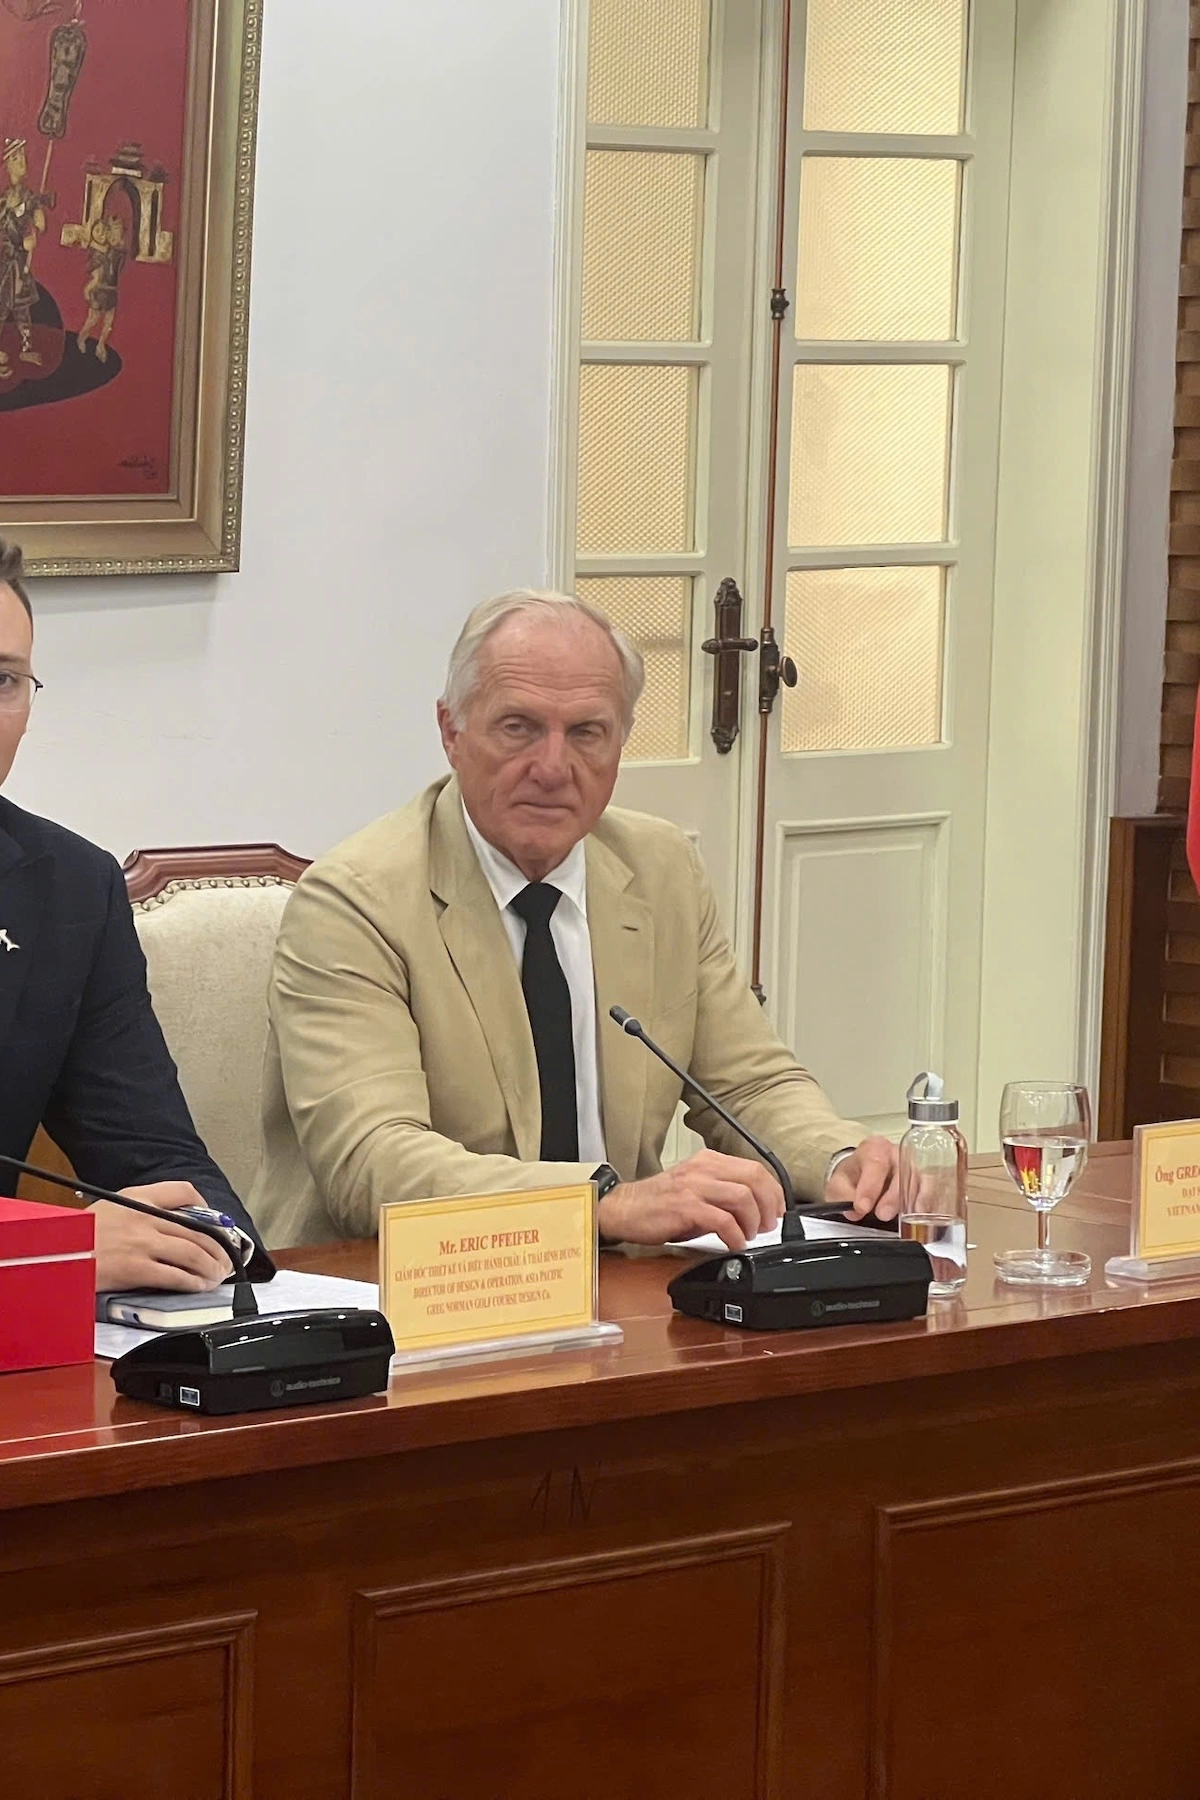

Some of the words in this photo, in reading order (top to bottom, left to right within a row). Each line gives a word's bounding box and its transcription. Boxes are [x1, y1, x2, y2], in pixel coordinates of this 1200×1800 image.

[1155, 1165, 1174, 1186] Ông
[1176, 1165, 1200, 1180] GRE
[439, 1240, 457, 1256] Mr.
[460, 1235, 489, 1253] ERIC
[491, 1229, 540, 1249] PFEIFER
[414, 1284, 446, 1299] DIRECTOR
[447, 1281, 456, 1294] OF
[456, 1279, 479, 1294] DESIGN
[446, 1300, 474, 1312] NORMAN
[474, 1297, 491, 1309] GOLF
